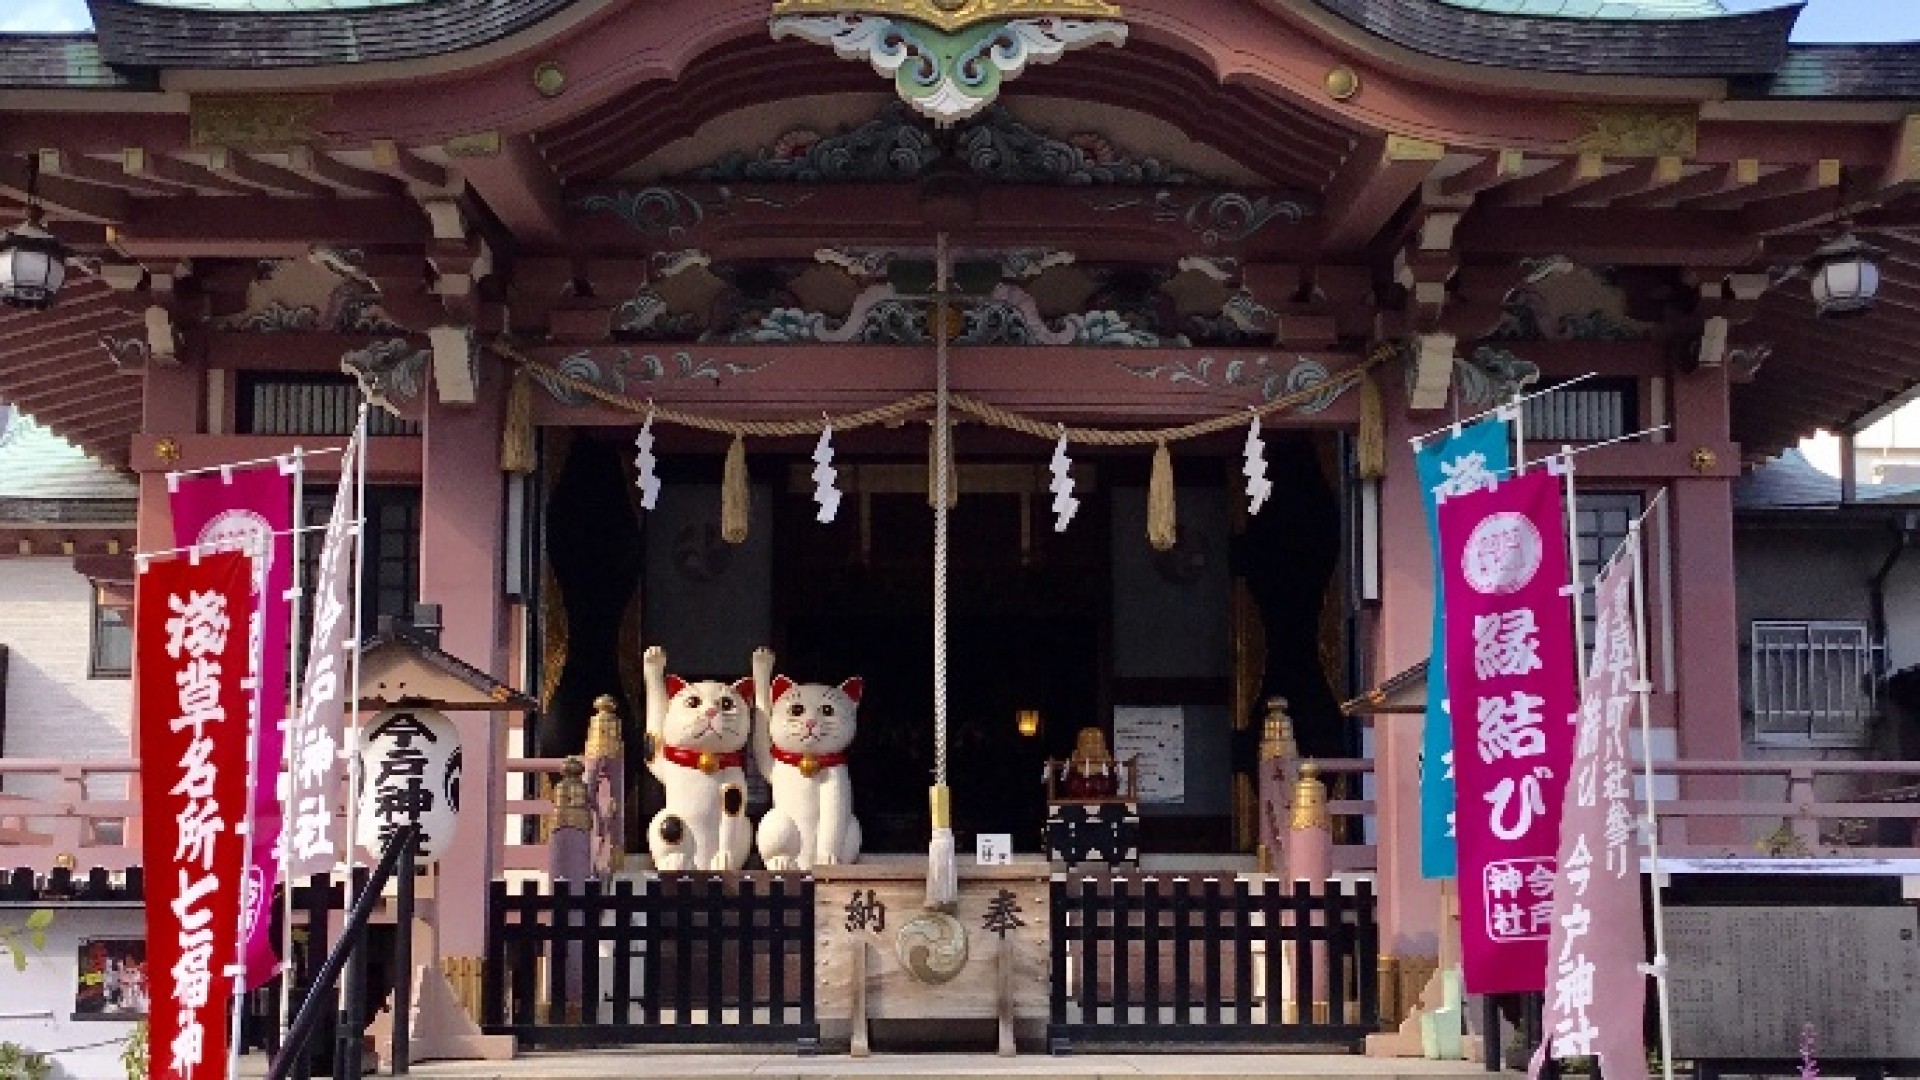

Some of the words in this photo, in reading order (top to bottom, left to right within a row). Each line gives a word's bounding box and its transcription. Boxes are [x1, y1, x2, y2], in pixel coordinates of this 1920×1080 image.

[1473, 606, 1554, 841] 縁結び
[1552, 833, 1600, 1059] 今戸神社
